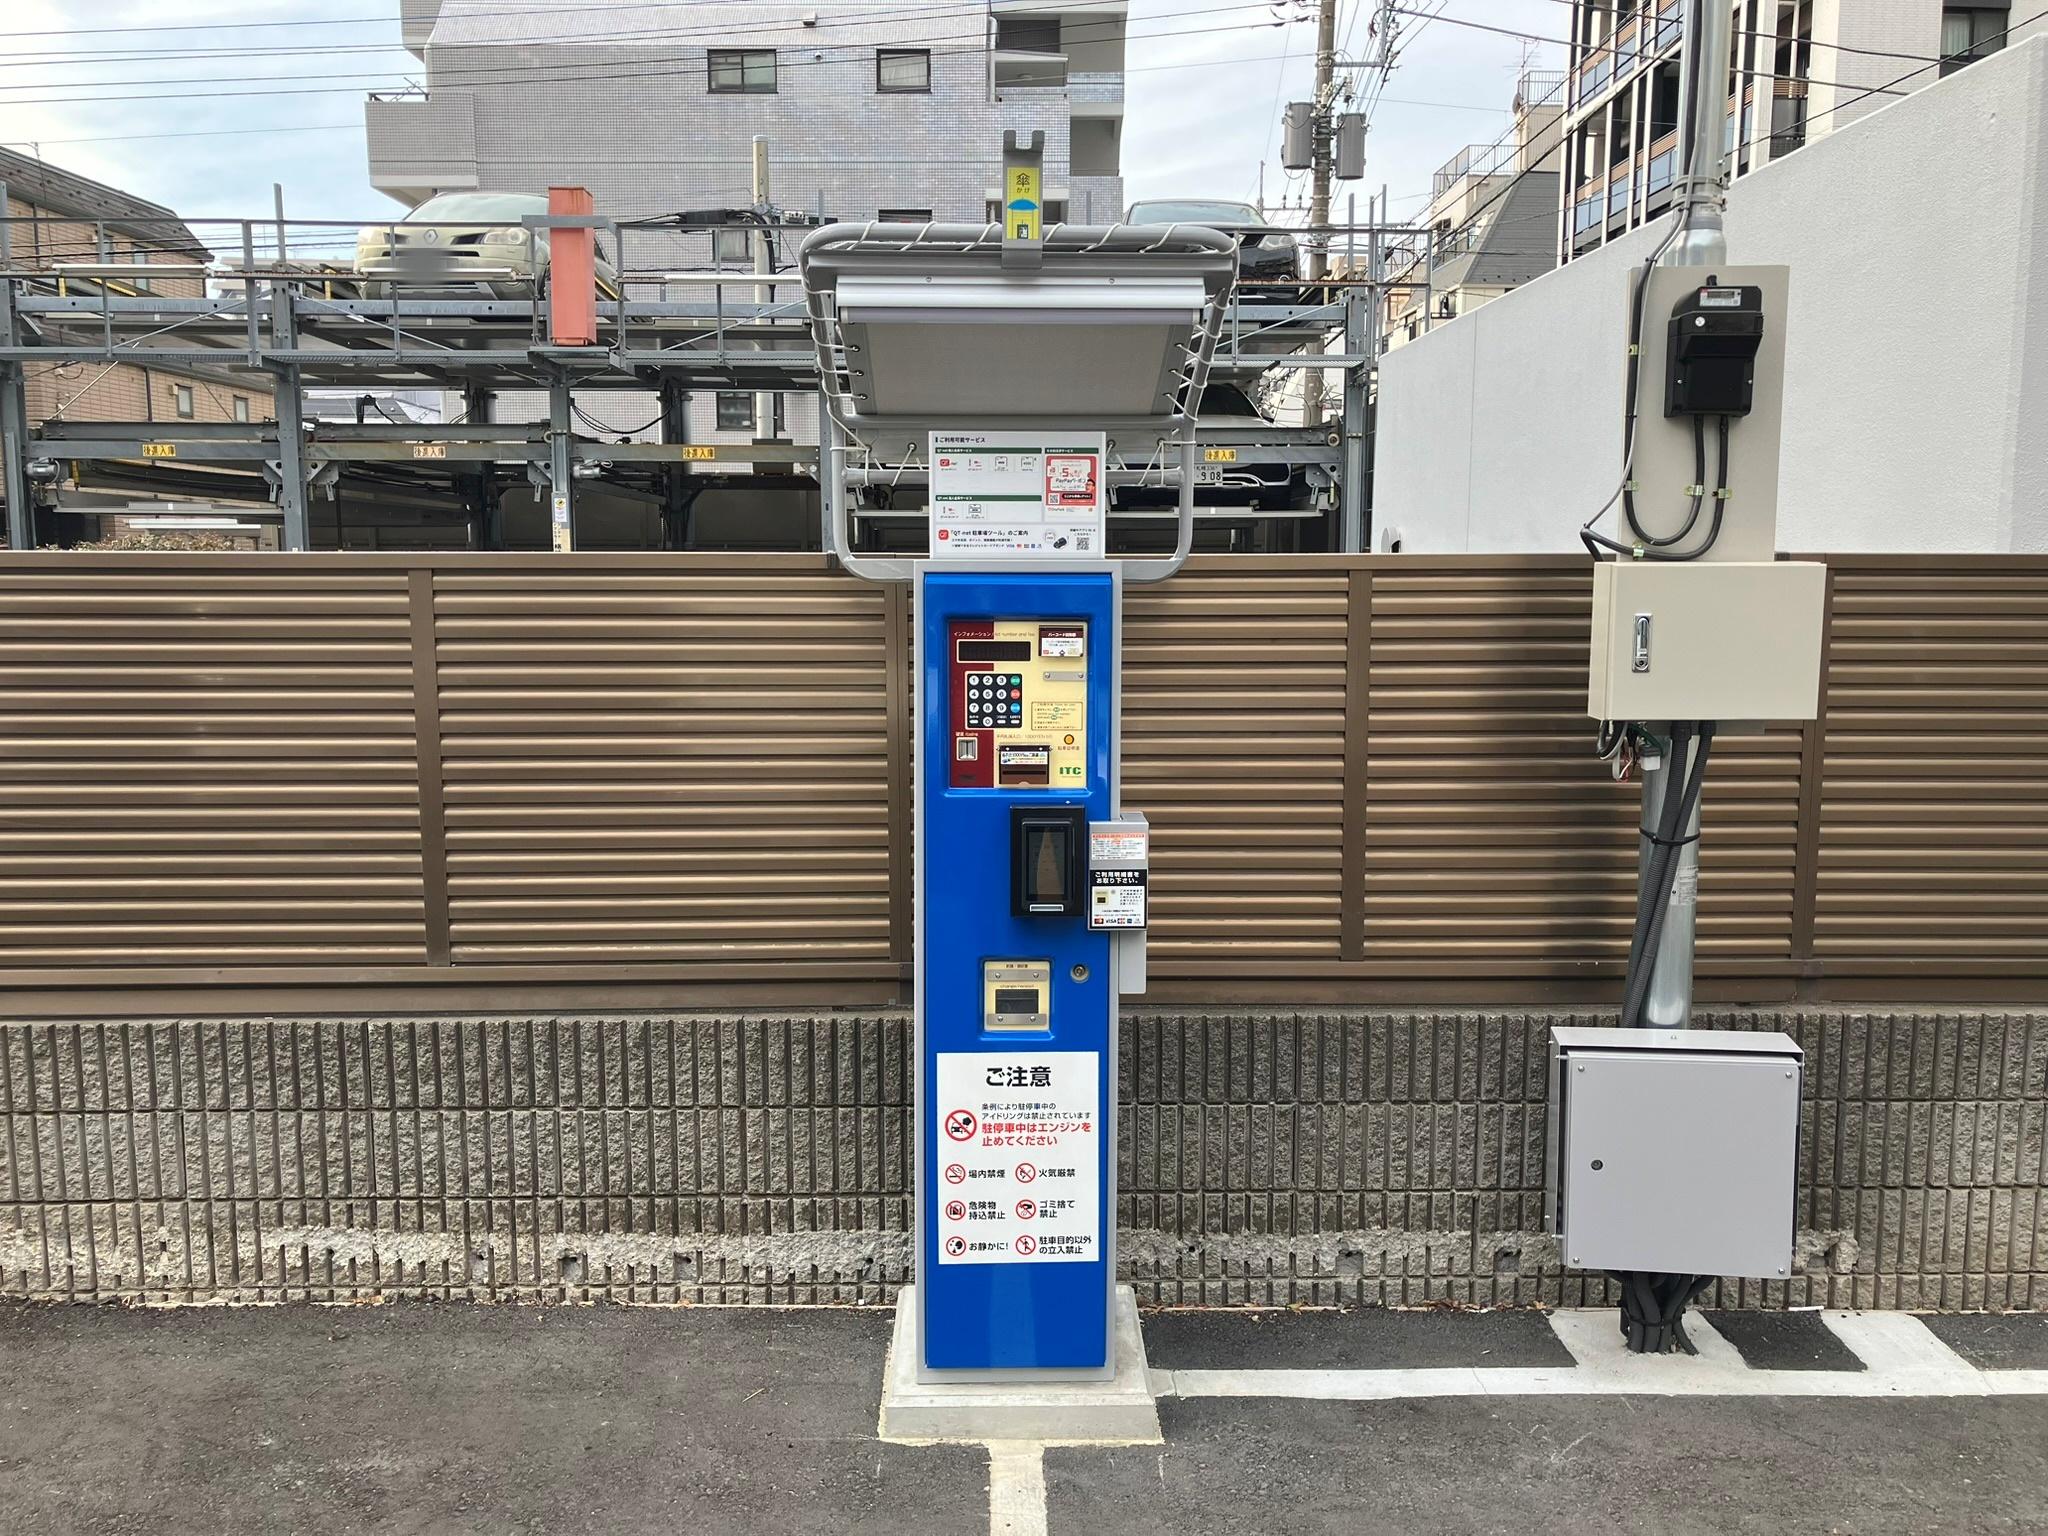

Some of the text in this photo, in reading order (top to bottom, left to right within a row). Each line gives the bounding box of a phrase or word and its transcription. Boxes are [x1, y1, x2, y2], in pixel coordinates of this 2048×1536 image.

[1016, 173, 1030, 187] 傘
[143, 446, 175, 456] 後進入庫
[414, 447, 446, 457] 後進入庫
[1059, 766, 1082, 775] ITC
[986, 1066, 1052, 1087] ご注意
[981, 1103, 1056, 1111] 条例により駐停車中の
[981, 1111, 1091, 1120] アイドリングは禁止されています
[981, 1122, 1091, 1133] 駐停車中はエンジンを
[982, 1135, 1058, 1147] 止めてください
[968, 1169, 1006, 1179] 場内禁煙
[1038, 1168, 1075, 1178] 火気厳禁
[968, 1201, 997, 1210] 危険物
[1039, 1200, 1075, 1209] ゴミ捨て
[968, 1211, 1006, 1220] 持込禁止
[1039, 1209, 1058, 1218] 禁止
[1039, 1235, 1092, 1245] 駐車目的以外
[1039, 1245, 1083, 1255] の立入禁止
